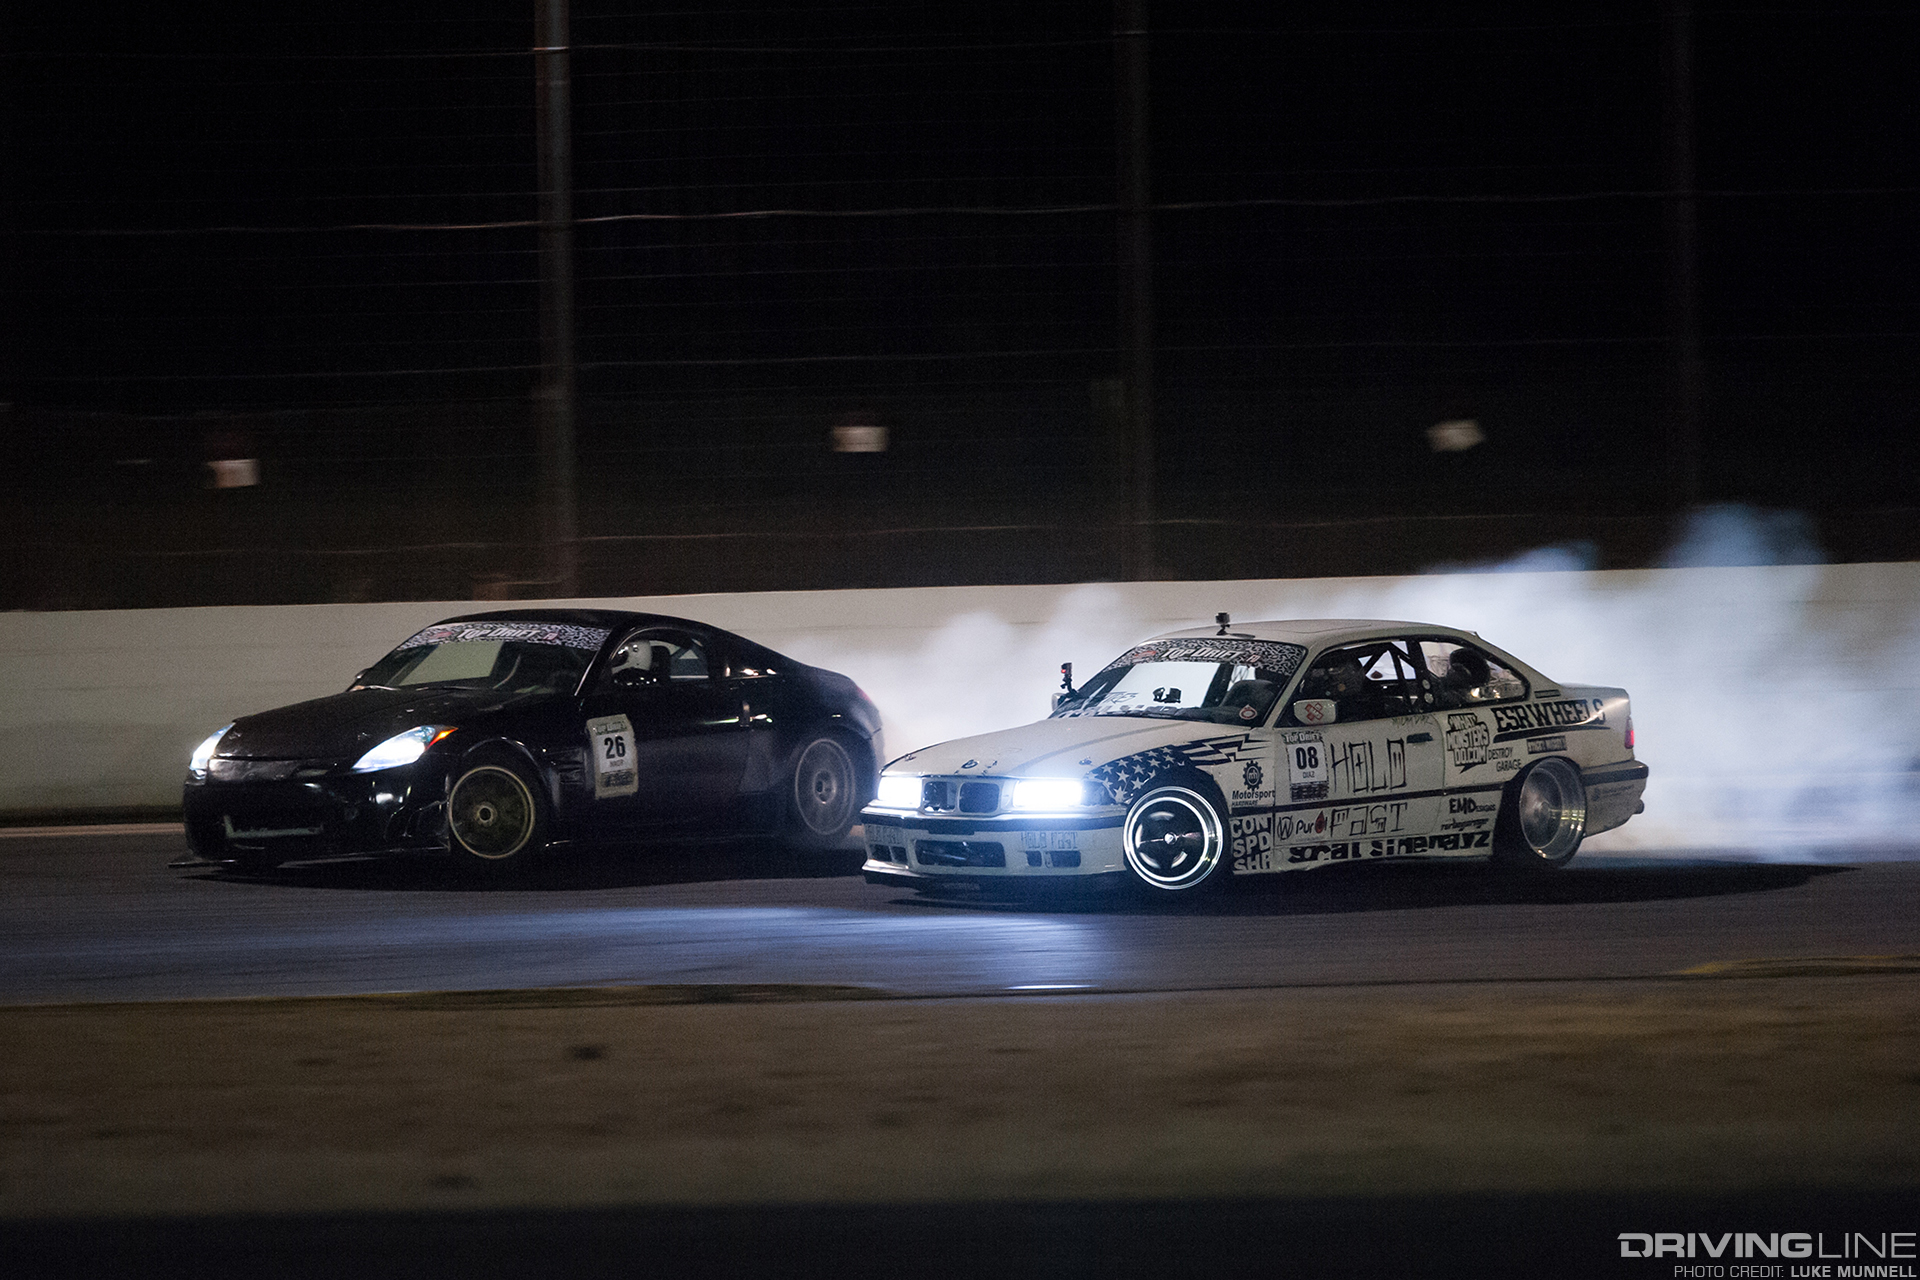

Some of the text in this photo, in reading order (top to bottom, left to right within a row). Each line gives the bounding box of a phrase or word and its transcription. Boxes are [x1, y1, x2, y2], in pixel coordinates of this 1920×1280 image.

[458, 628, 491, 639] TOP
[488, 628, 541, 638] DRIFT
[1161, 647, 1245, 659] TOP DRIFT
[604, 736, 626, 759] 26
[1488, 747, 1513, 760] DESTROY
[1295, 746, 1319, 770] 08
[1496, 759, 1522, 772] GARAGE
[1232, 790, 1275, 800] Motorsport
[1231, 816, 1270, 838] CON
[1233, 831, 1270, 858] SPD
